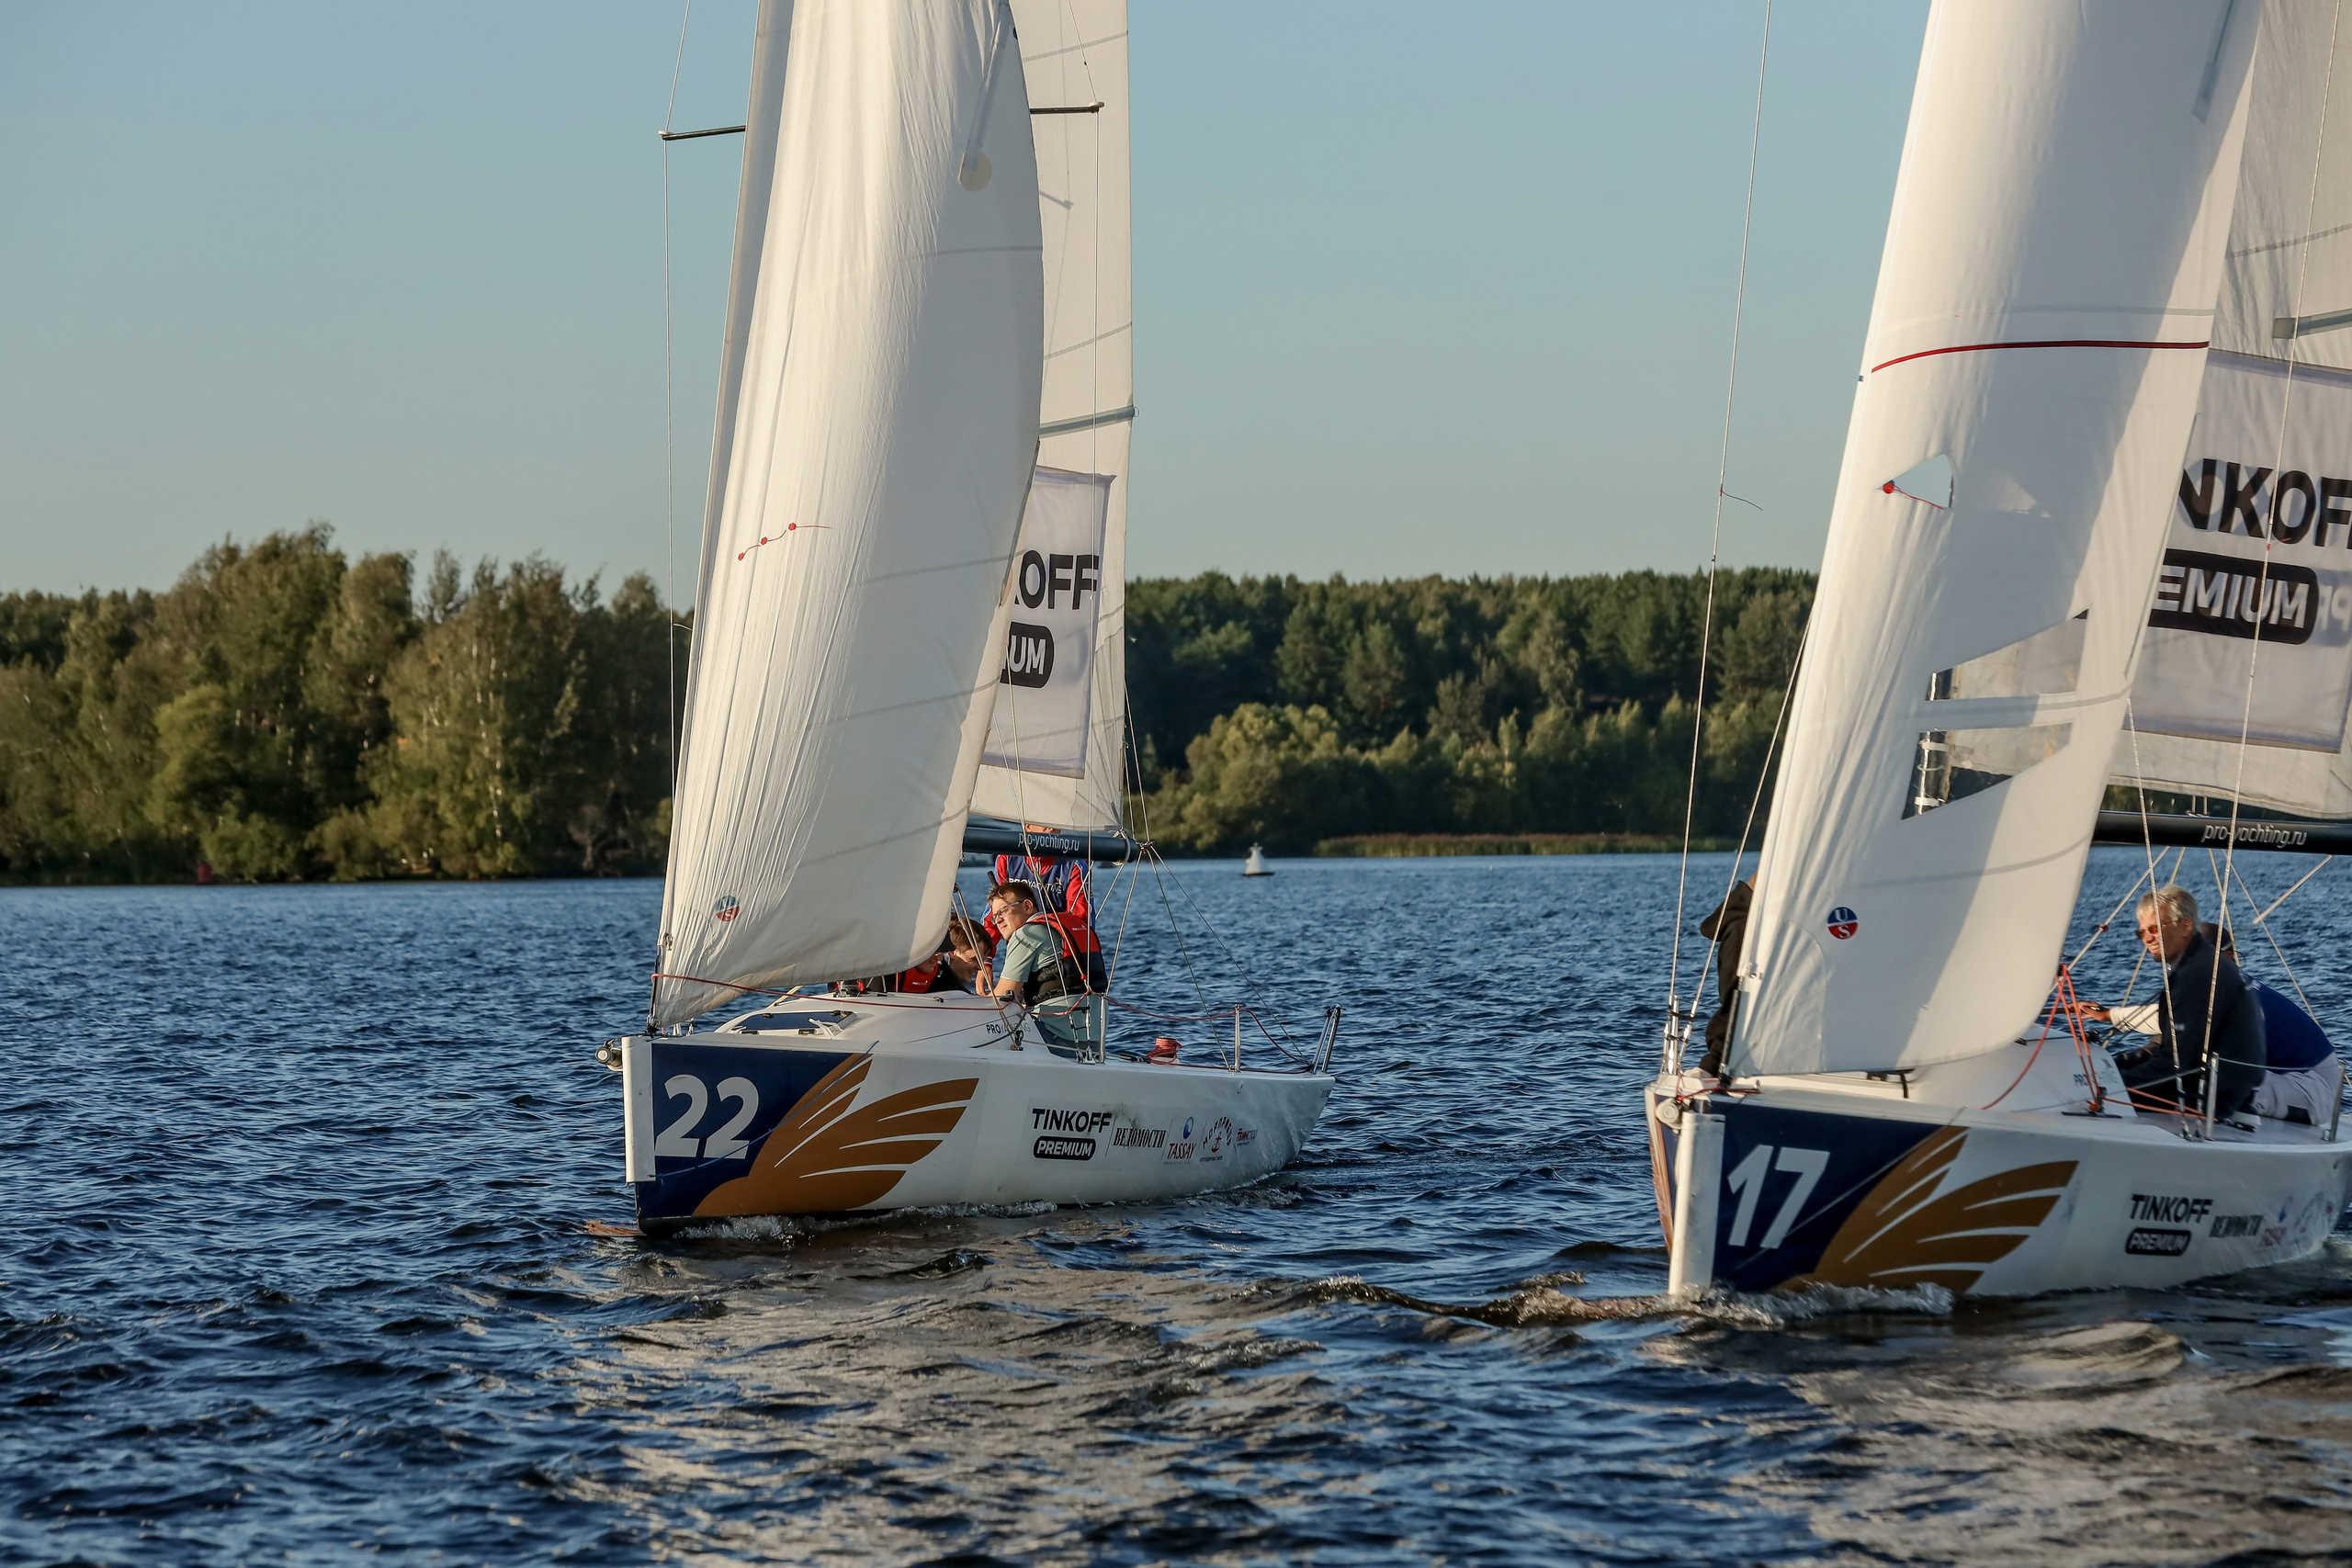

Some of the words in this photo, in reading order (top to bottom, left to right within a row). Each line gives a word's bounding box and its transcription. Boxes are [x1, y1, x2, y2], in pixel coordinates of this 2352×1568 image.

[2179, 458, 2352, 549] NKOF
[1014, 549, 1099, 610] OFF
[1018, 833, 1080, 854] po-yachting.ru
[655, 1074, 759, 1159] 22
[1032, 1108, 1113, 1134] TINKOFF
[1036, 1140, 1093, 1156] PREMIUM
[1113, 1127, 1167, 1149] ВЕДОМОСТИ
[1167, 1143, 1197, 1159] TASSAY
[1727, 1144, 1831, 1249] 17
[2129, 1194, 2214, 1224] TINKOFF
